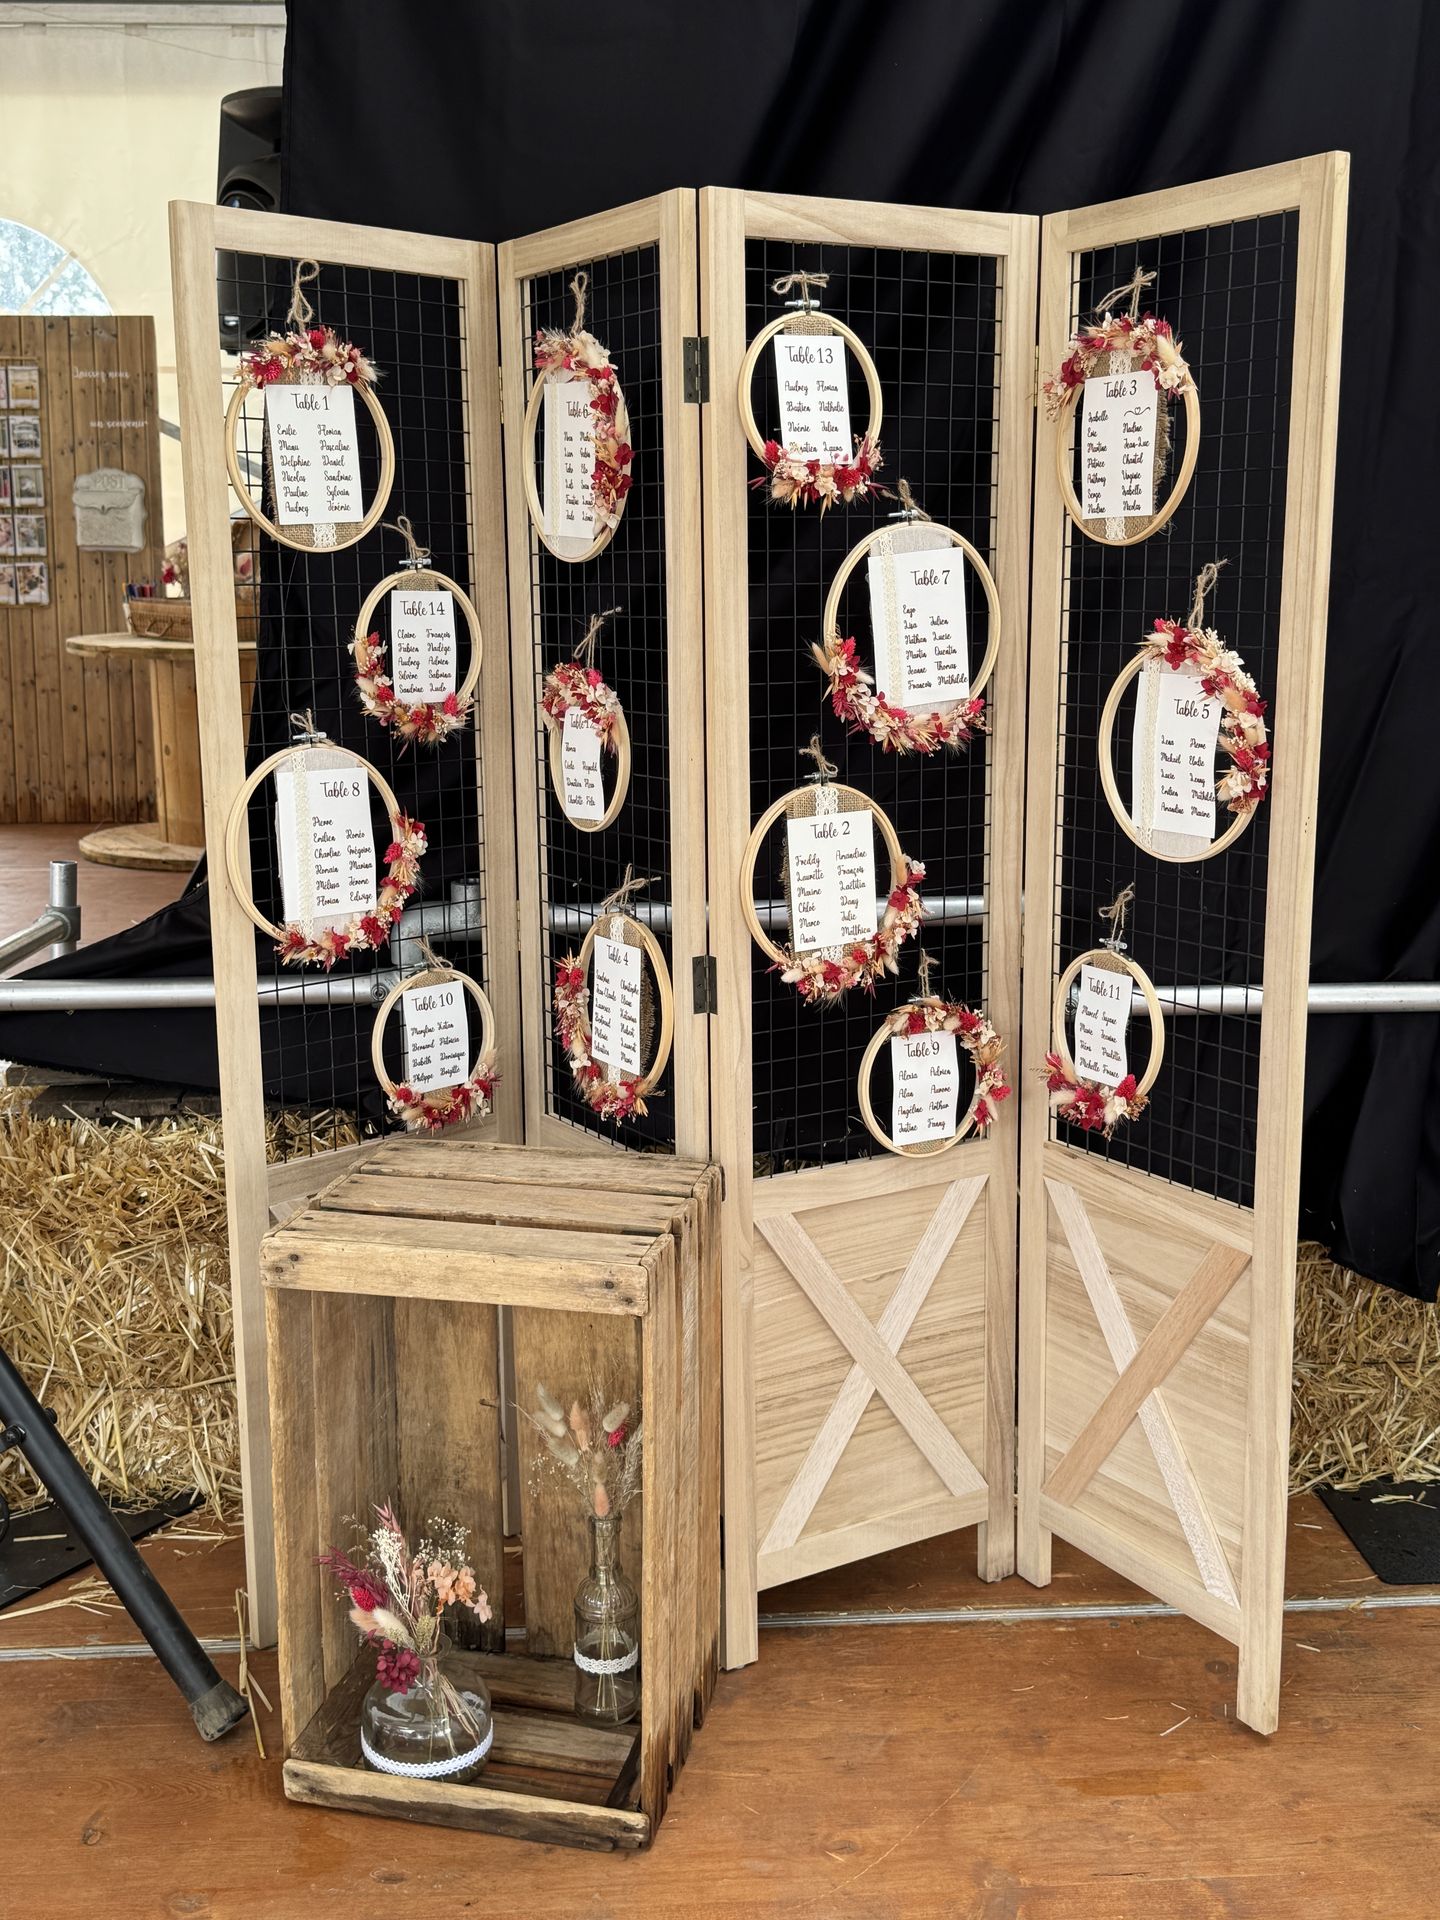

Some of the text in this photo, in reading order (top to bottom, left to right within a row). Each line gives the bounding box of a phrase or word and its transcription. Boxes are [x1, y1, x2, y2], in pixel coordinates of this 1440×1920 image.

[784, 346, 833, 364] Table 13
[784, 381, 808, 395] Audrey
[816, 381, 838, 392] Florian
[1104, 380, 1137, 398] Table 3
[290, 393, 329, 410] Table 1
[786, 401, 811, 412] Bastien
[819, 401, 844, 412] Nathalie
[567, 401, 588, 418] Table 6
[317, 424, 341, 436] Florian
[821, 421, 839, 432] Julien
[280, 456, 311, 471] Delphine
[322, 455, 345, 466] Daniel
[95, 473, 126, 489] POST
[282, 471, 306, 482] Nicolas
[324, 471, 352, 481] Sandrine
[283, 486, 309, 497] Pauline
[327, 486, 350, 500] Sylvain
[285, 502, 309, 516] Audrey
[910, 569, 950, 586] Table 7
[400, 601, 445, 616] Table 14
[929, 616, 949, 626] Julien
[905, 634, 927, 645] Nathan
[934, 645, 957, 656] Quentin
[398, 657, 420, 669] Audrey
[429, 656, 449, 665] Adrien
[934, 661, 957, 671] Thomas
[938, 673, 968, 685] Mathilde
[399, 683, 424, 694] Sandrine
[1174, 699, 1209, 719] Table 5
[570, 714, 584, 729] Table
[320, 781, 360, 798] Table 8
[312, 817, 333, 827] Pierre
[810, 821, 850, 839] Table 2
[314, 848, 341, 859] Charline
[836, 848, 867, 861] Amandine
[795, 853, 820, 868] Freddy
[796, 869, 824, 882] Laurette
[317, 896, 340, 906] Florian
[798, 902, 816, 913] Chloé
[840, 911, 857, 921] Julie
[607, 945, 628, 966] Table 4
[1088, 977, 1120, 1000] Table 11
[412, 992, 453, 1011] Table 10
[412, 1039, 435, 1052] Bernard
[904, 1041, 939, 1057] Table 9
[440, 1052, 466, 1060] Dominique
